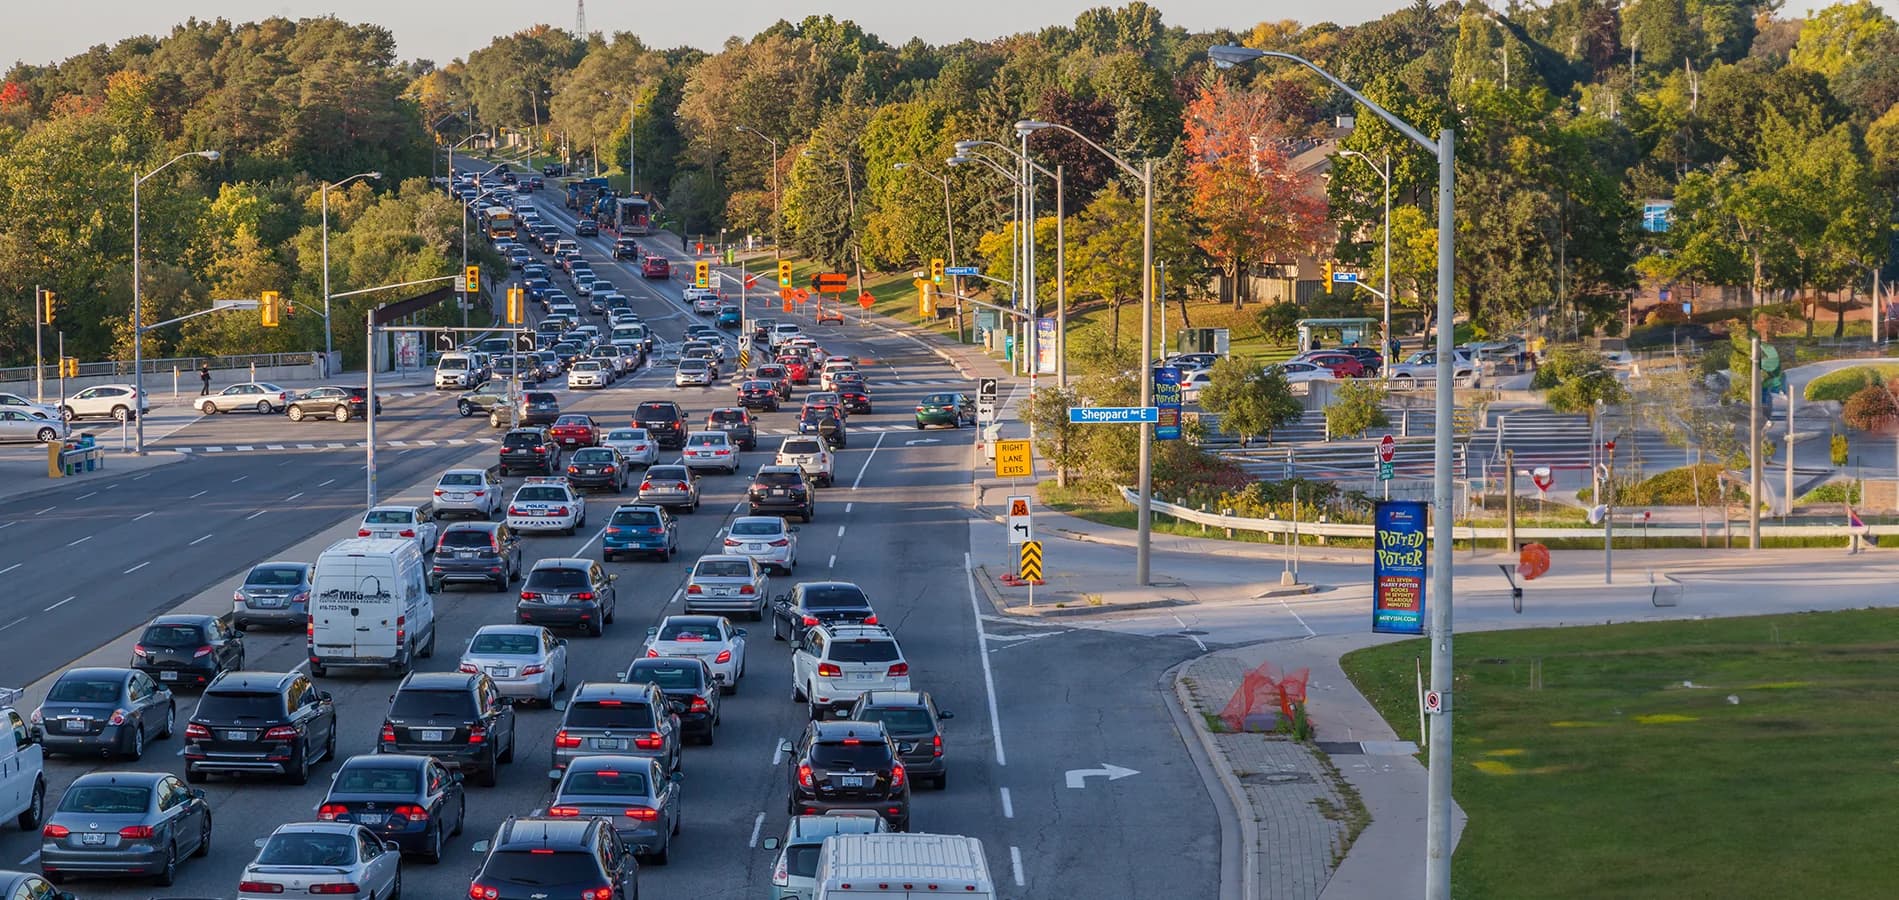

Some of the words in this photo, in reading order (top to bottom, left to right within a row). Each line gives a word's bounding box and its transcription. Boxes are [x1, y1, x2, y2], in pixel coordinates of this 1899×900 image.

[1157, 383, 1181, 394] POTTED
[1155, 393, 1180, 405] POTTER
[1081, 409, 1128, 421] Sheppard
[1140, 409, 1147, 419] E
[1002, 444, 1023, 452] RIGHT
[1382, 443, 1395, 455] STOP
[1003, 465, 1024, 473] EXITS
[1013, 504, 1026, 516] D-6
[1378, 530, 1424, 549] POTTED
[1376, 549, 1423, 570] POTTER
